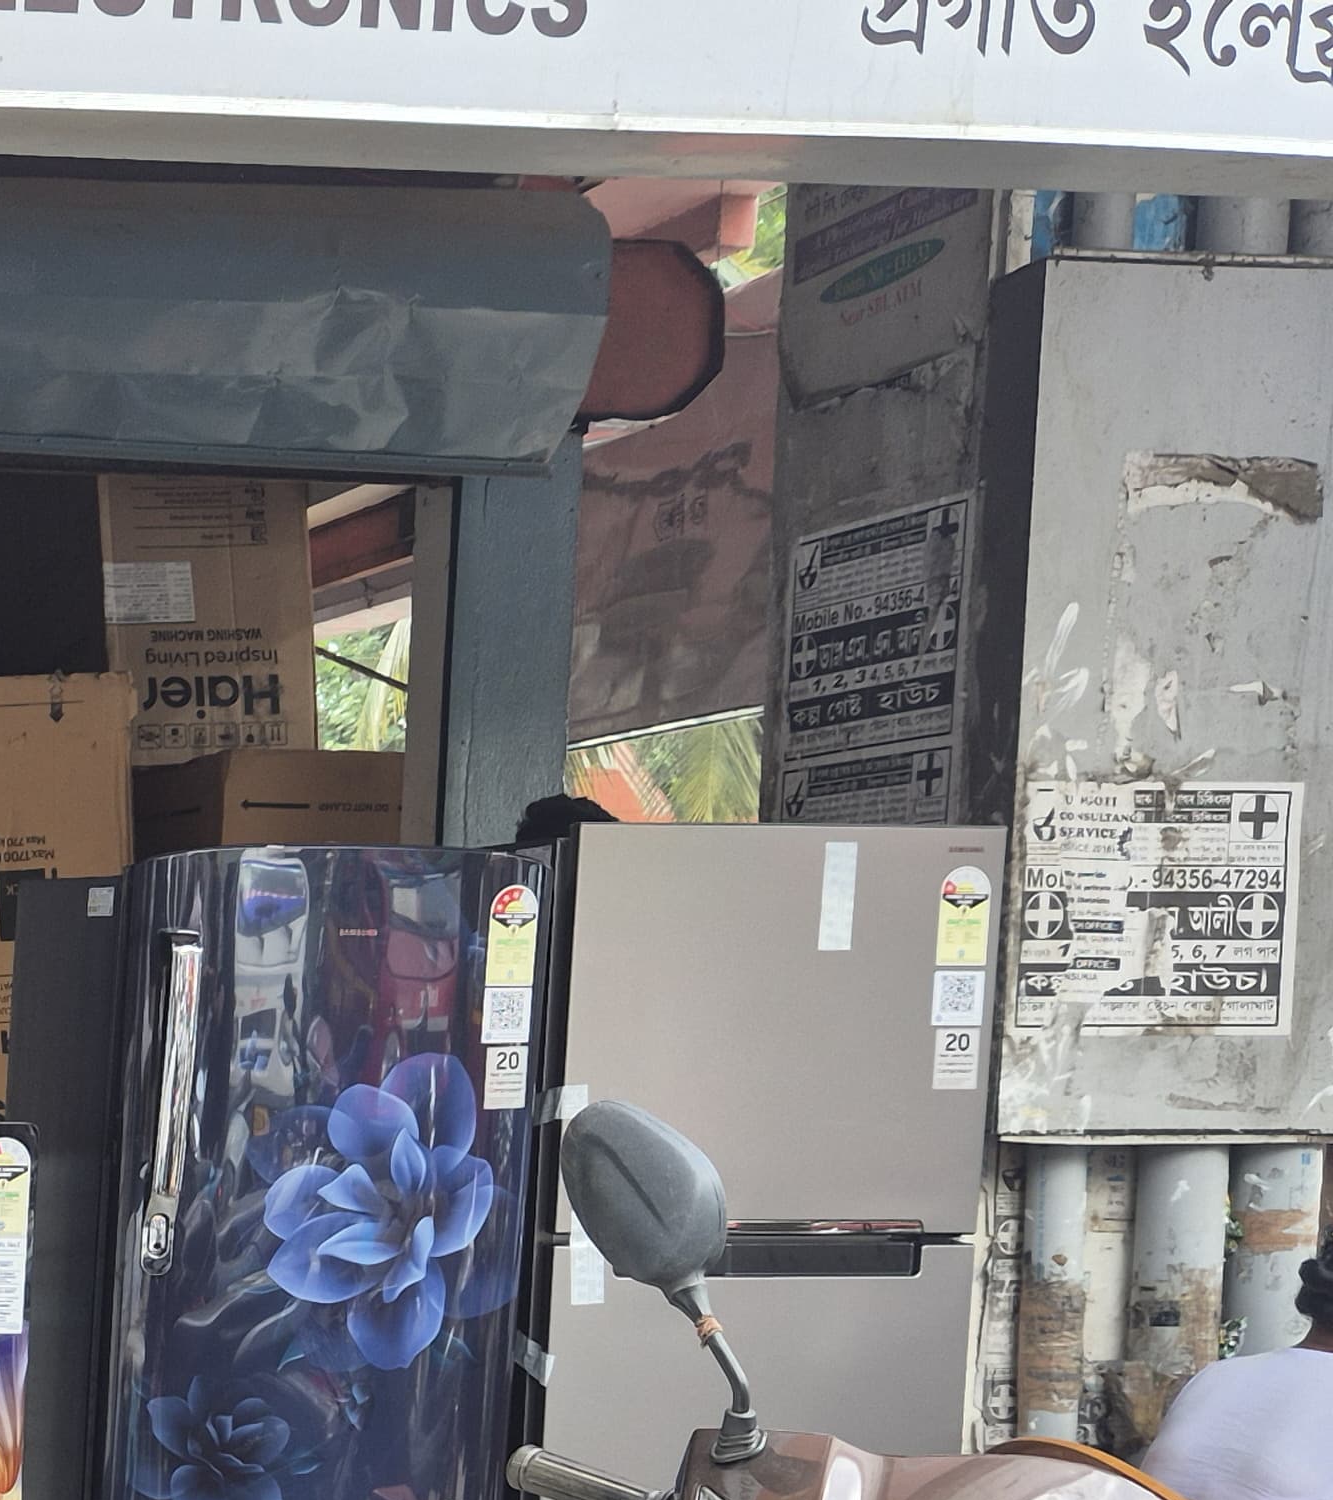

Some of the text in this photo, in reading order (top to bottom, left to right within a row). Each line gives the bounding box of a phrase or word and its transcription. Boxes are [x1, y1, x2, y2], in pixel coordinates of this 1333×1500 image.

[794, 607, 839, 633] Mobile
[150, 628, 262, 642] WASHING MACHINE
[145, 647, 278, 666] Inspired Living
[143, 674, 281, 720] Haier
[1058, 828, 1118, 840] SERVICE
[1151, 868, 1282, 890] 94356-47294
[945, 1033, 971, 1052] 20
[496, 1051, 520, 1070] 20
